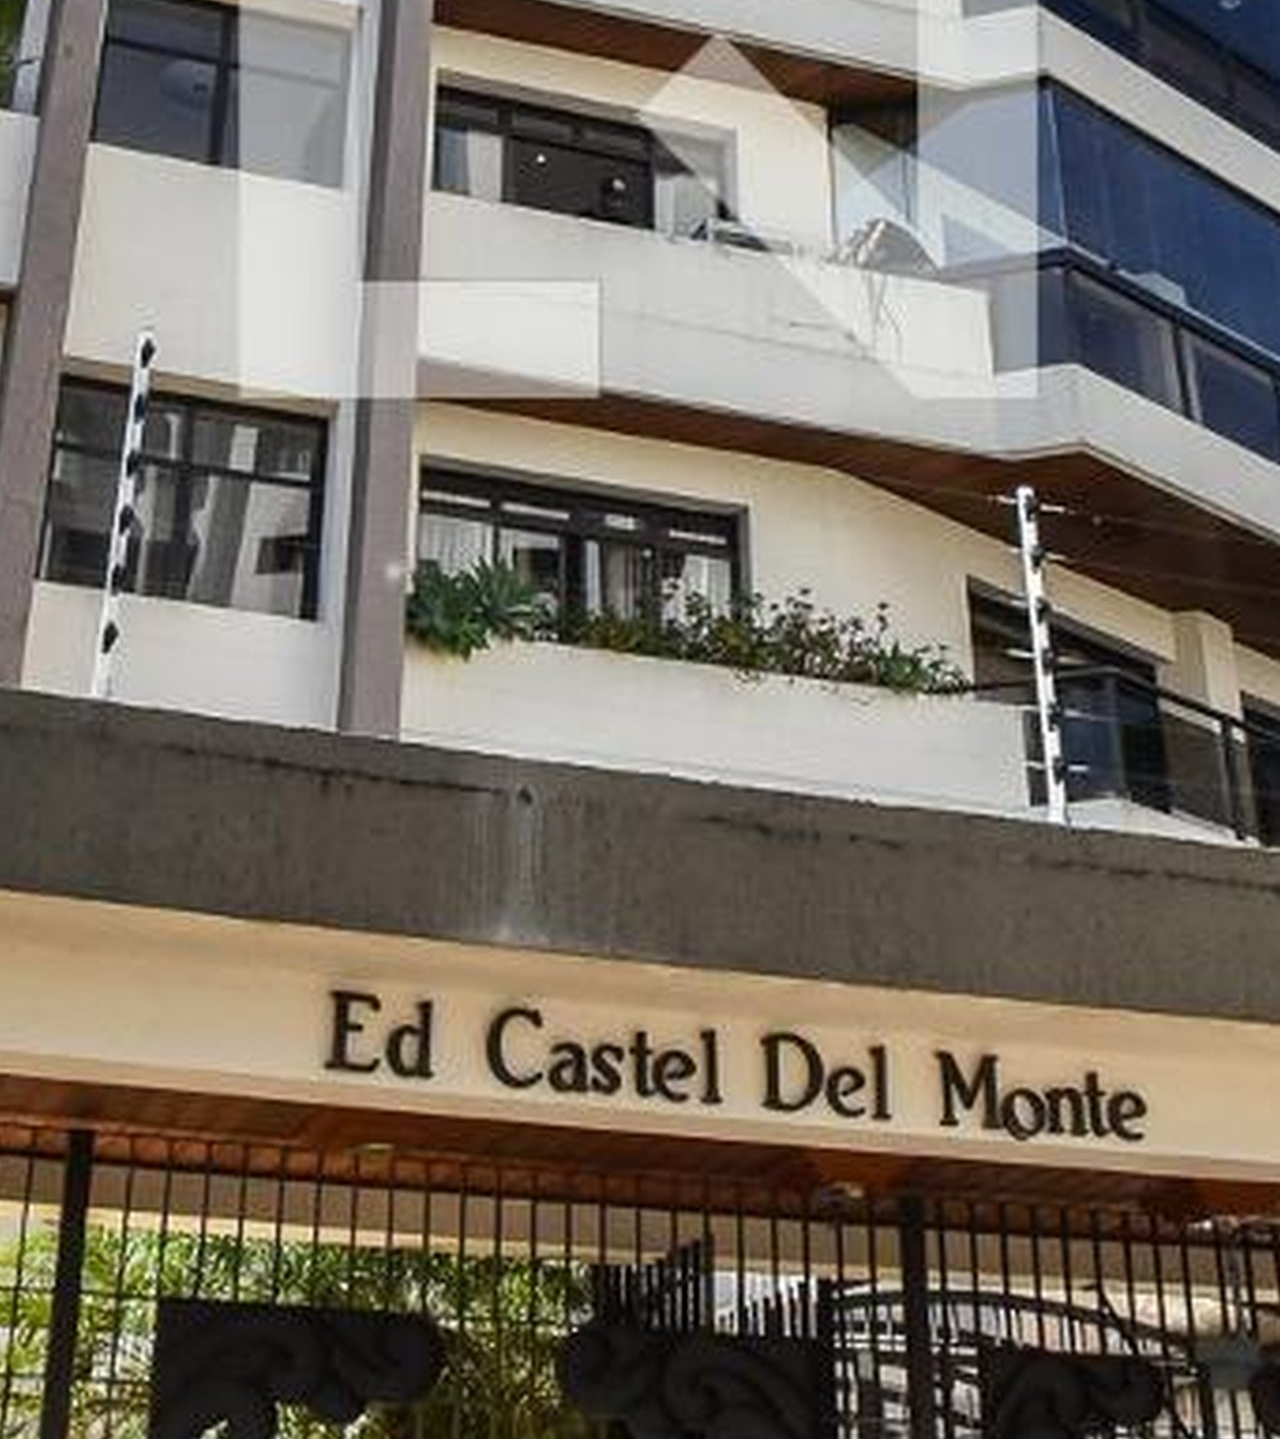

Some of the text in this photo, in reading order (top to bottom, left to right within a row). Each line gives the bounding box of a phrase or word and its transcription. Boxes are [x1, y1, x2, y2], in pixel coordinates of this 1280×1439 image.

[323, 989, 1148, 1142] Ed Castel Del Monte
